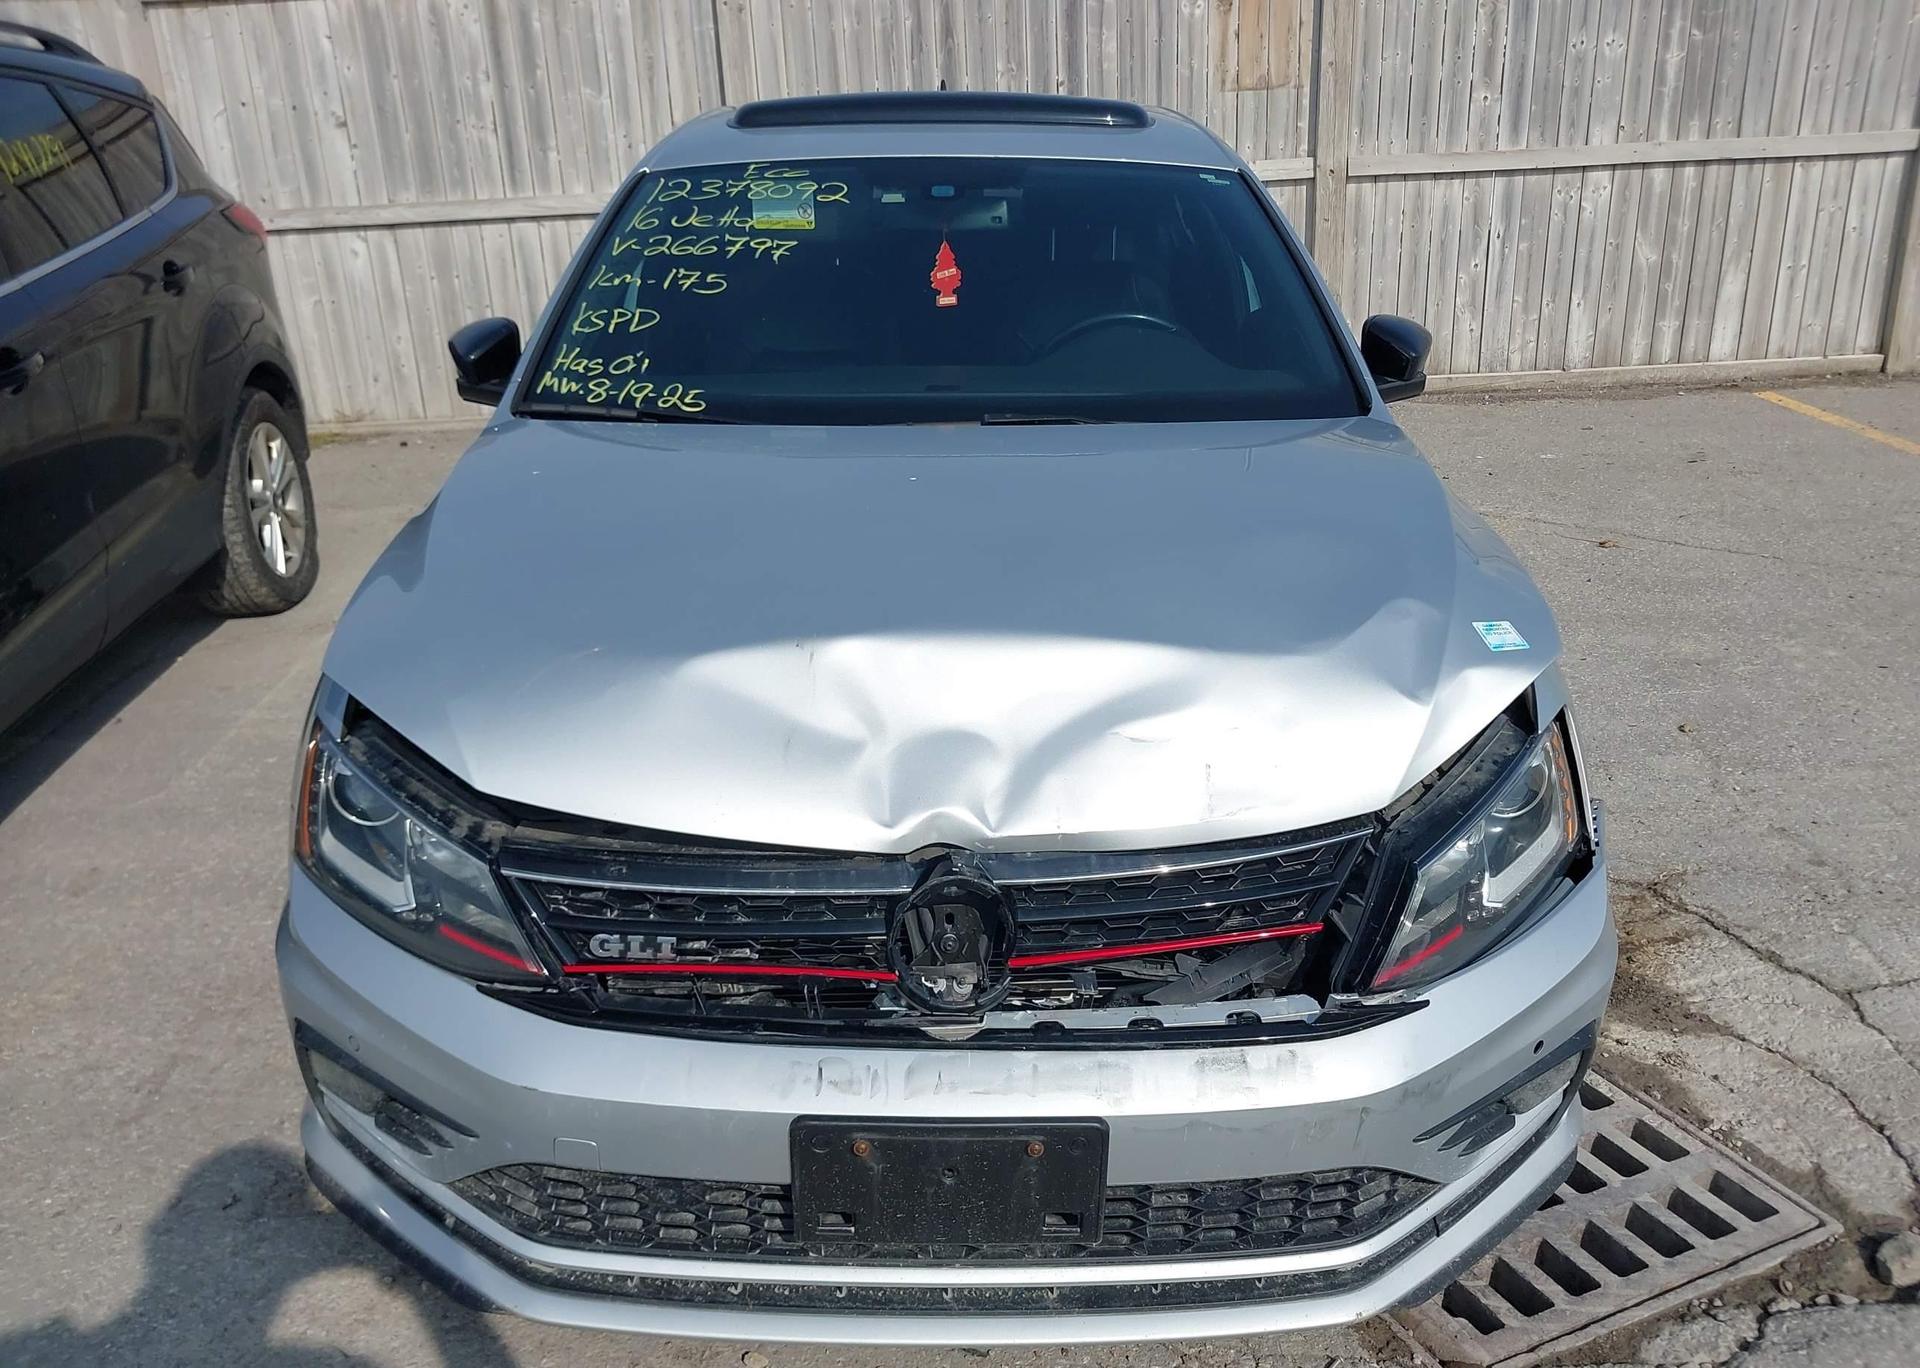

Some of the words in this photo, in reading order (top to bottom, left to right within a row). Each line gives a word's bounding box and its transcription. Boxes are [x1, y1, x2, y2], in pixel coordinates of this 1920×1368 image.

[647, 178, 850, 204] 12378092
[625, 205, 663, 233] 16
[553, 343, 604, 376] Has
[589, 933, 678, 960] GLI
